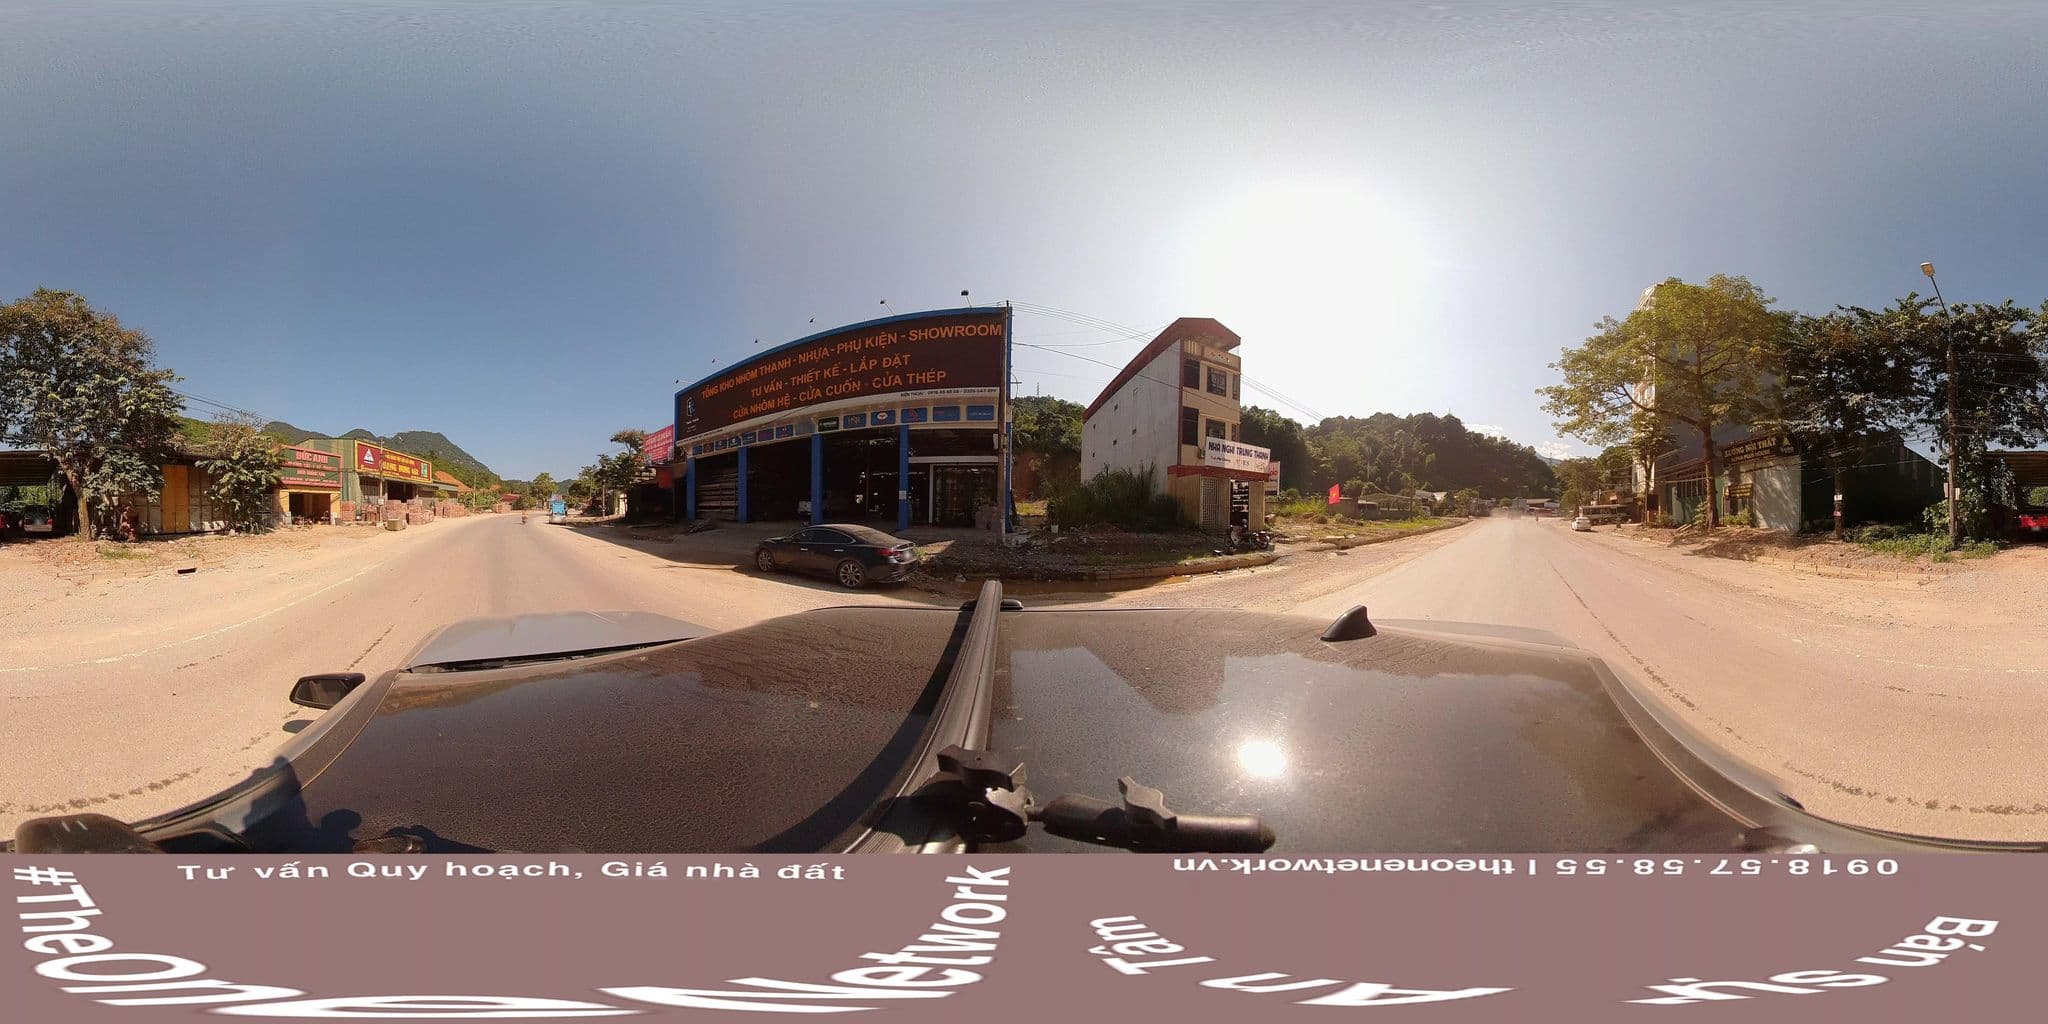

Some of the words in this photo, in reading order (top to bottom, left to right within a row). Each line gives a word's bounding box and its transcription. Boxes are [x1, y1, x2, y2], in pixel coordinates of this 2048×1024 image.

[701, 385, 720, 400] TỔNG
[719, 378, 735, 393] KHO
[735, 367, 759, 385] NHÔM
[759, 357, 792, 376] THANH
[798, 346, 830, 365] NHỰA
[837, 338, 862, 354] PHỤ
[865, 331, 898, 349] KIỆN
[908, 324, 1002, 342] SHOWROOM
[751, 387, 763, 398] TƯ
[763, 380, 783, 394] VẤN
[790, 367, 821, 387] THIẾT
[823, 361, 842, 379] KẾ
[850, 355, 878, 374] LẮP
[882, 353, 911, 370] ĐẶT
[733, 404, 749, 419] CỬA
[750, 398, 775, 415] NHÔM
[777, 392, 791, 409] HỆ
[799, 385, 822, 402] CỬA
[826, 377, 861, 396] CUỐN
[872, 371, 903, 389] CỬA
[906, 367, 947, 385] THÉP
